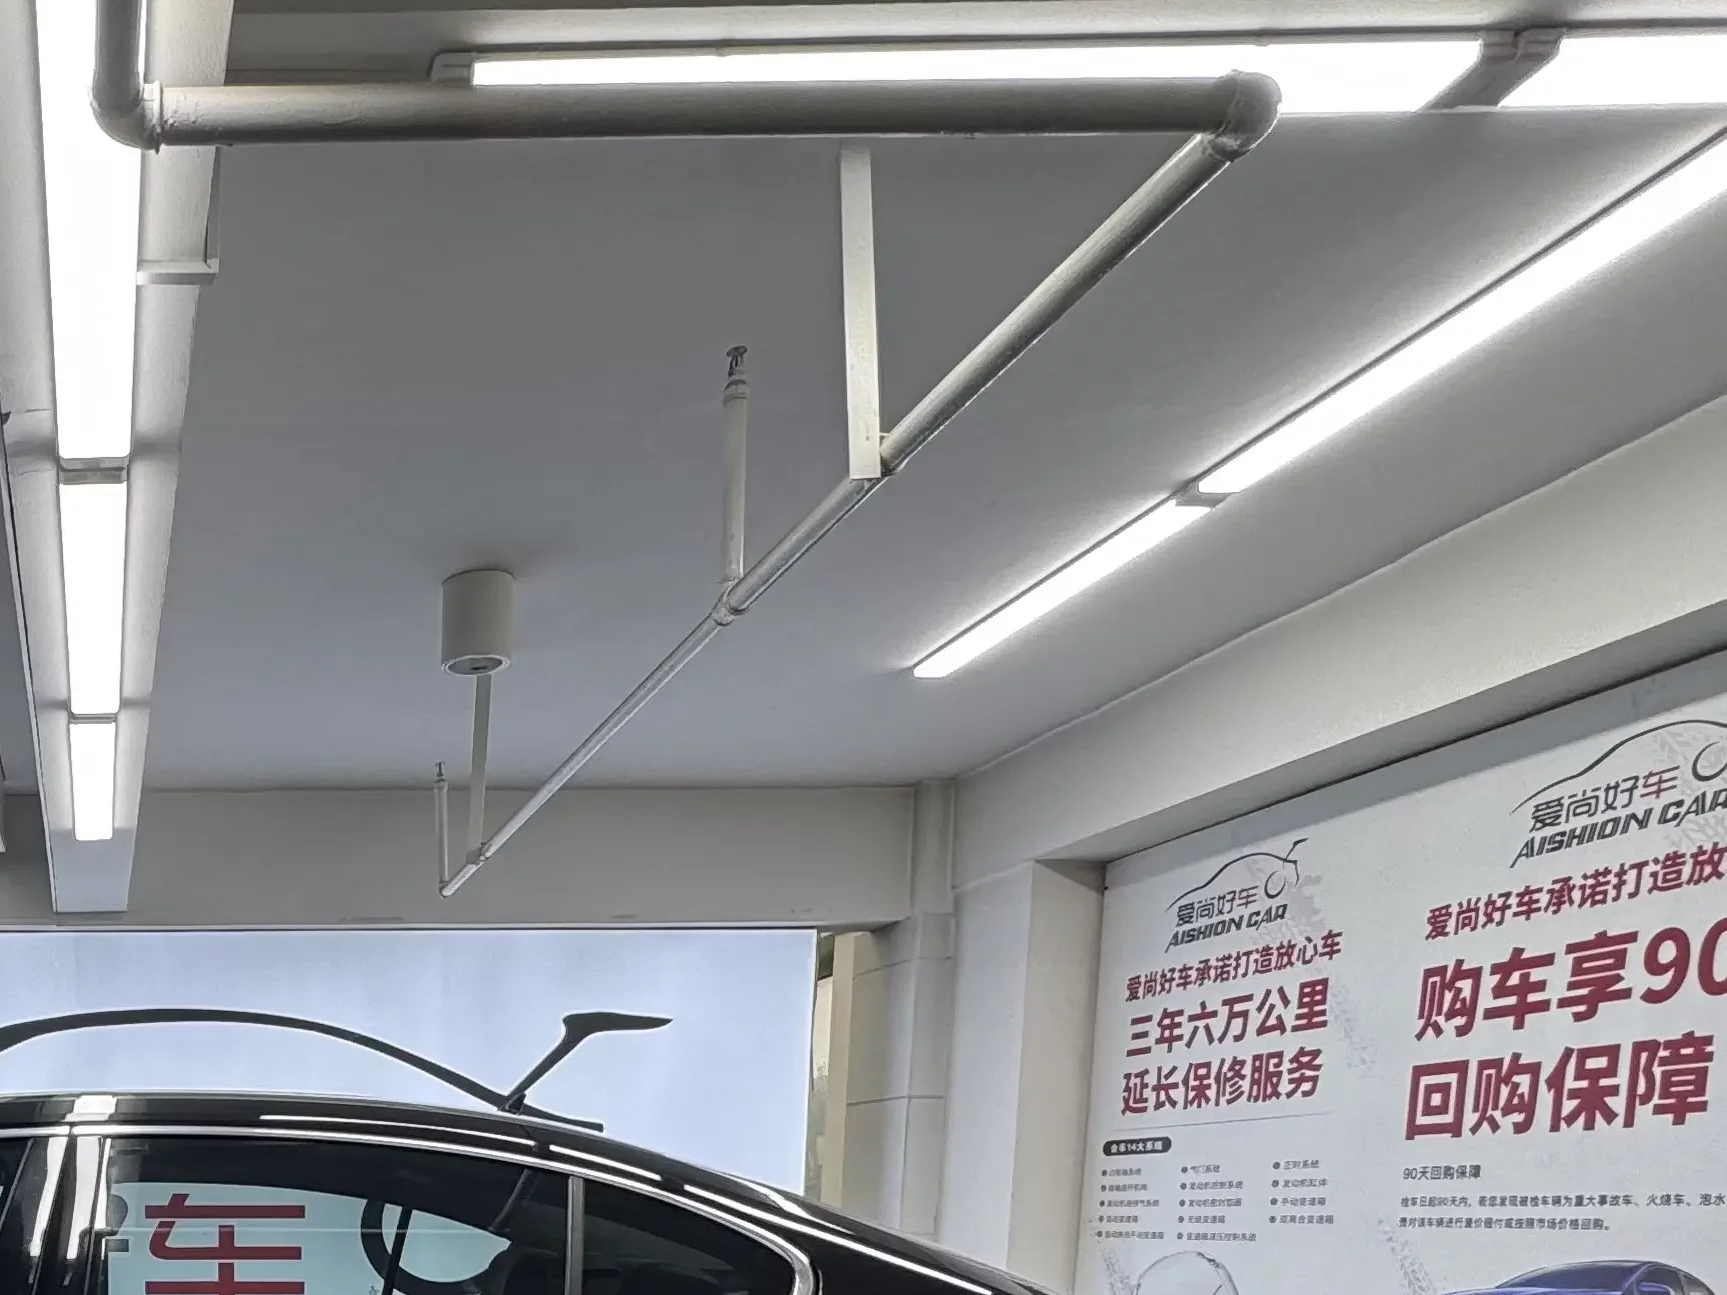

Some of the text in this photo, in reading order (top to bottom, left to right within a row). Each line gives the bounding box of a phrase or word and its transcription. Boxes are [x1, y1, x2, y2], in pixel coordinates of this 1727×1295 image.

[1529, 765, 1680, 832] 爱尚好车
[1165, 915, 1243, 953] AISHION
[1175, 885, 1259, 927] 爱尚好车
[1126, 930, 1343, 1002] 爱尚好车承诺打造放心车
[1126, 977, 1329, 1057] 三年六万公里
[1121, 1046, 1323, 1116] 延长保修服务
[1405, 1030, 1714, 1140] 回购保障
[1403, 1164, 1481, 1180] 90天回购保障
